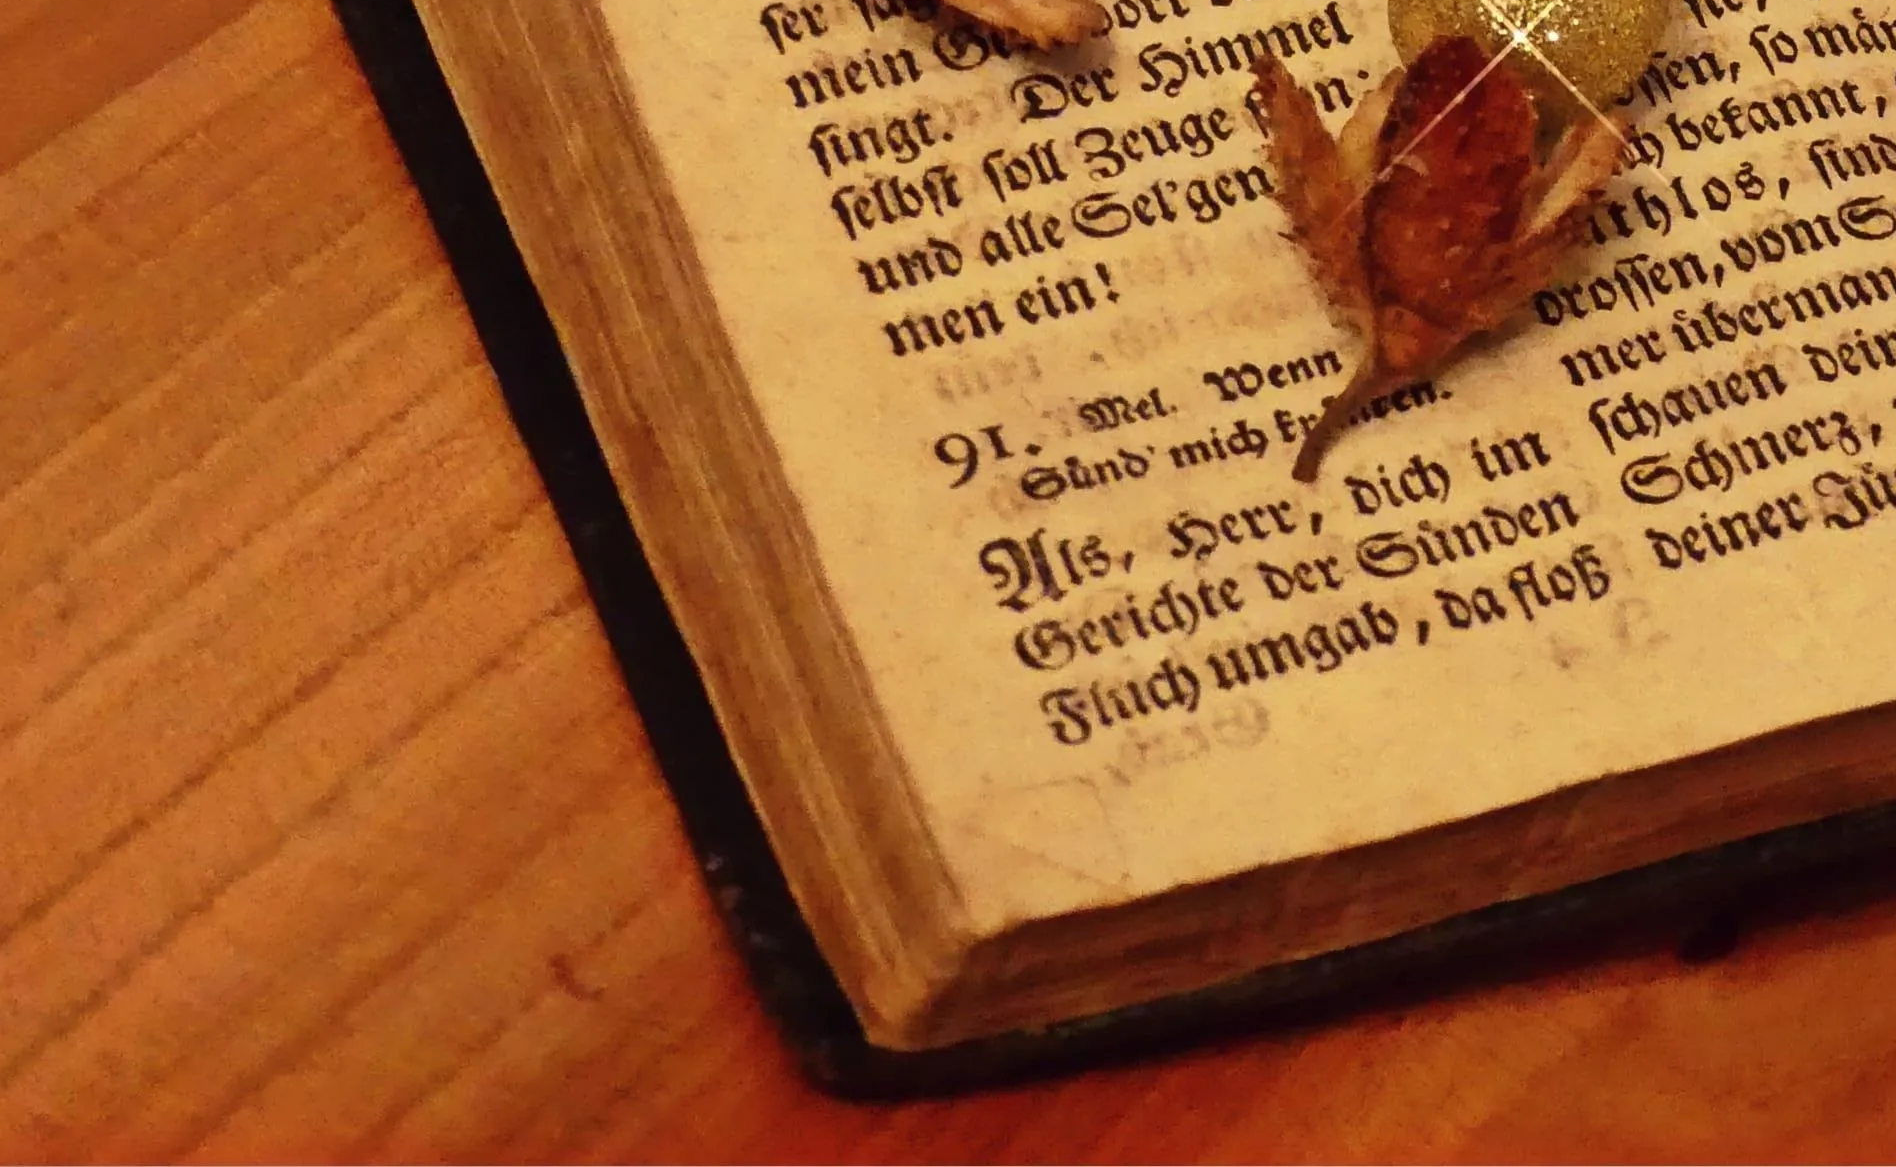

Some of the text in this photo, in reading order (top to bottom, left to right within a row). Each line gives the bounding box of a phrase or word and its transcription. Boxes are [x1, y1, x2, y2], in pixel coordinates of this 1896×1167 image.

[785, 48, 922, 109] mein
[857, 211, 1065, 295] und alle
[1722, 214, 1841, 273] vom
[882, 298, 1005, 357] men
[1559, 329, 1668, 387] mer
[1168, 418, 1269, 469] mich
[1343, 454, 1452, 515] dich
[1470, 431, 1552, 482] im
[1644, 492, 1810, 570] deiner
[1256, 555, 1342, 601] der
[1434, 586, 1508, 630] da
